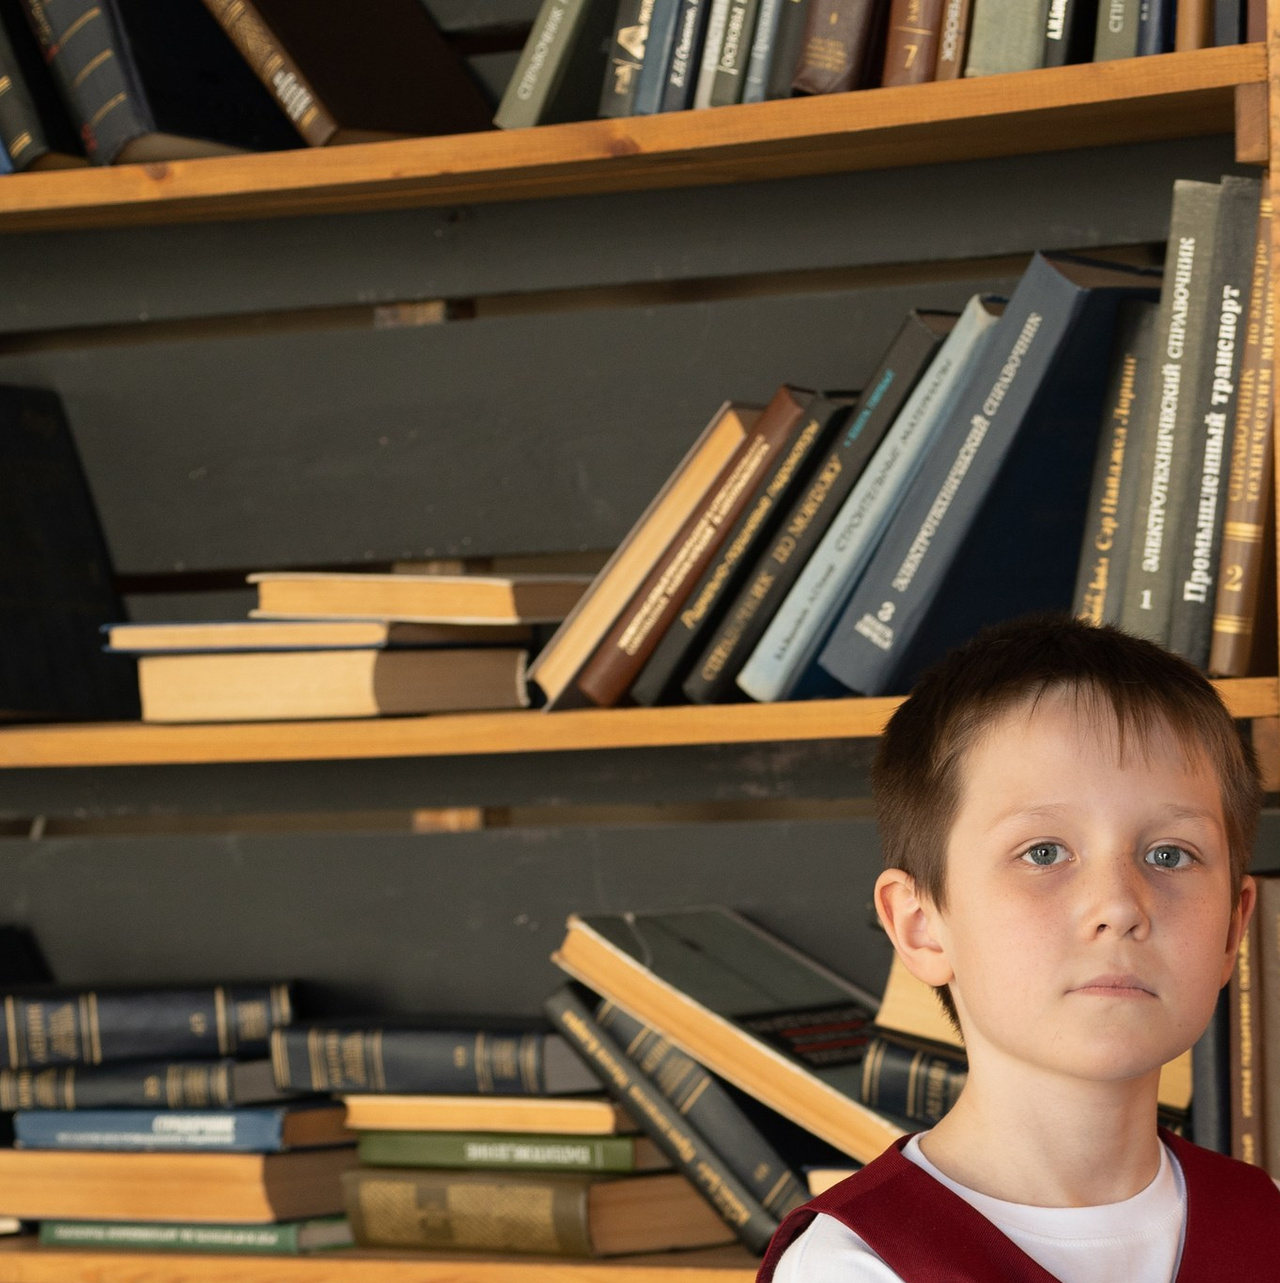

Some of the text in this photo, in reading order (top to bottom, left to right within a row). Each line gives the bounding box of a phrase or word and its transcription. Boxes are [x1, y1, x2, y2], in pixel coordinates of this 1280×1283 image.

[890, 310, 1044, 593] ЭЛЕКТРОТЕХНИЧЕСКИЙ СПРАВОЧНИК
[1113, 353, 1138, 426] Лоринг
[1142, 237, 1195, 573] ЭЛЕКТРОТЕХНИЧЕСКИЙ СПРАВОЧНИК
[1184, 285, 1241, 602] Промышленный транспорт
[1228, 369, 1255, 501] СПРАВОЧНИК
[1249, 324, 1260, 345] по
[1247, 369, 1271, 500] техническим
[831, 444, 905, 554] СТРОИТЕЛЬНЫЕ
[898, 357, 953, 446] МАТЕРИАЛЫ
[1100, 427, 1128, 515] Найджел
[769, 533, 797, 564] ПО
[1095, 516, 1119, 551] Сэр
[1225, 565, 1243, 592] 2
